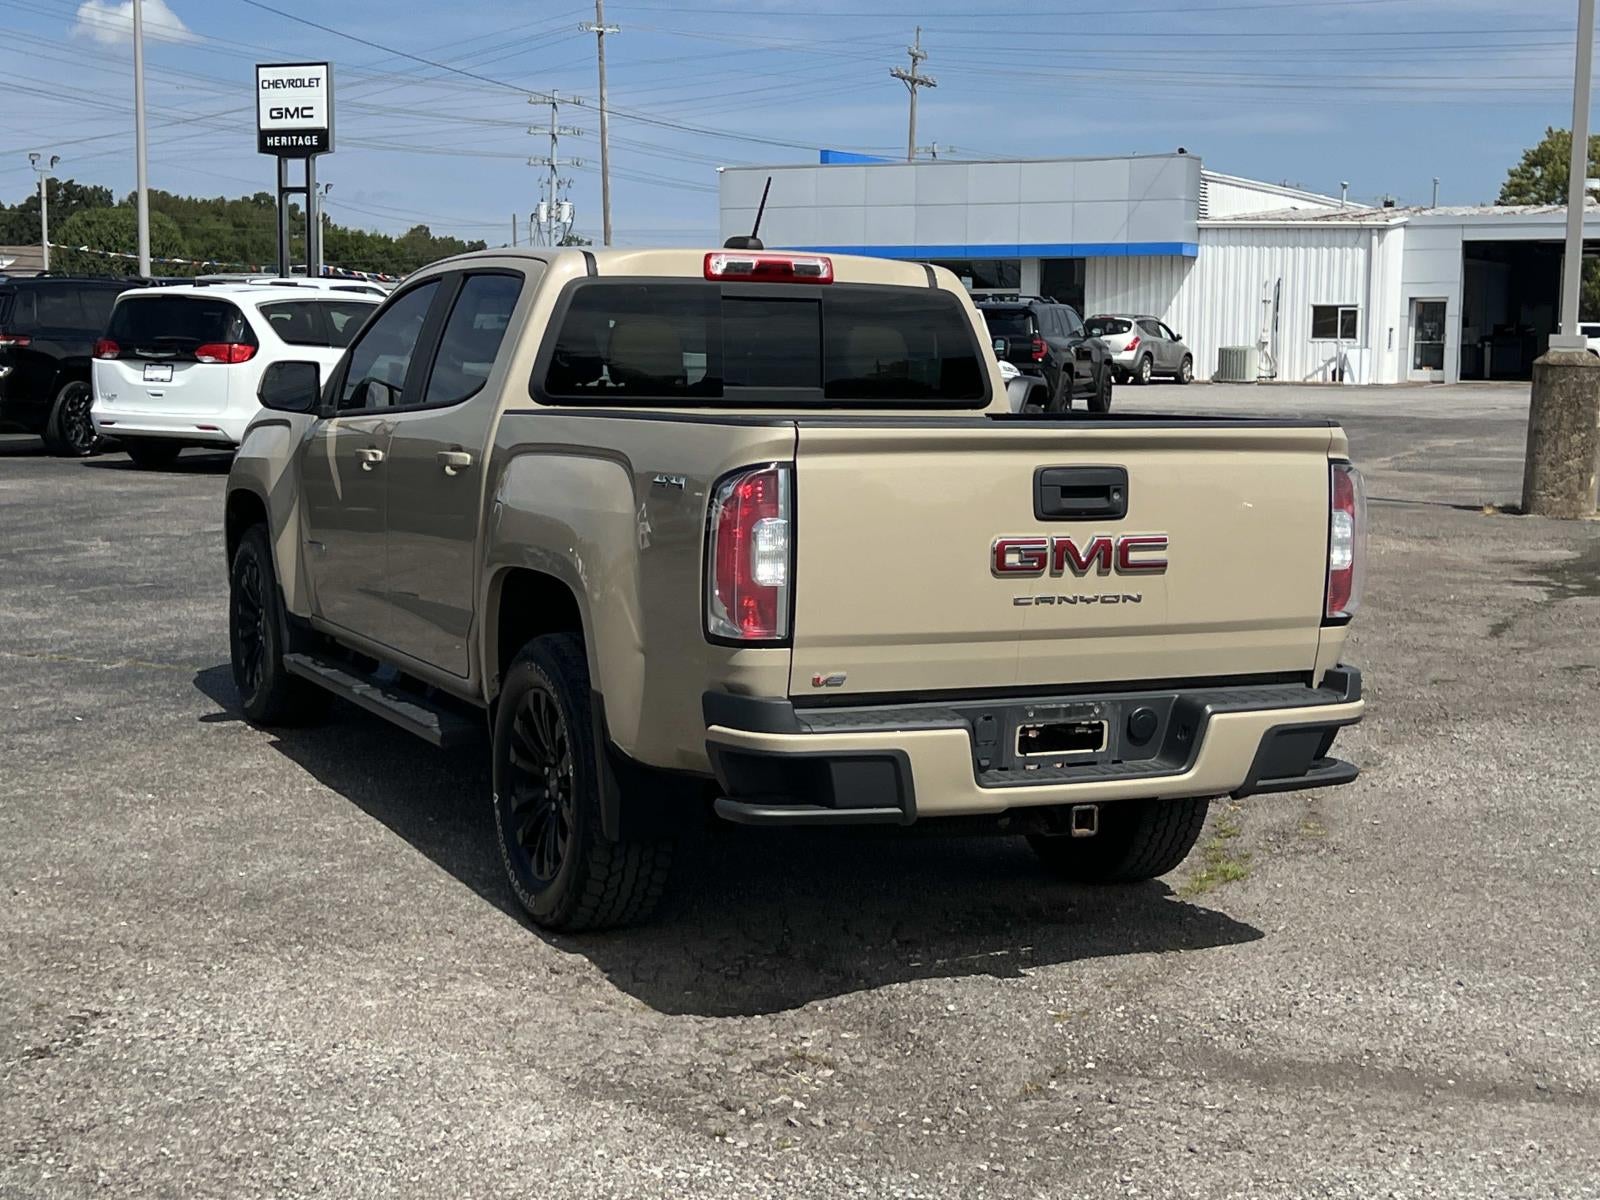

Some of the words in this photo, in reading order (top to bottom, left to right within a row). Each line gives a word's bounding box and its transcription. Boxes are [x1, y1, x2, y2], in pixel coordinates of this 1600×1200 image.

[261, 77, 320, 89] CHEVROLET
[269, 106, 314, 119] GMC
[266, 135, 319, 146] HERITAGE
[991, 532, 1169, 579] GMC
[1013, 593, 1143, 607] CANYON
